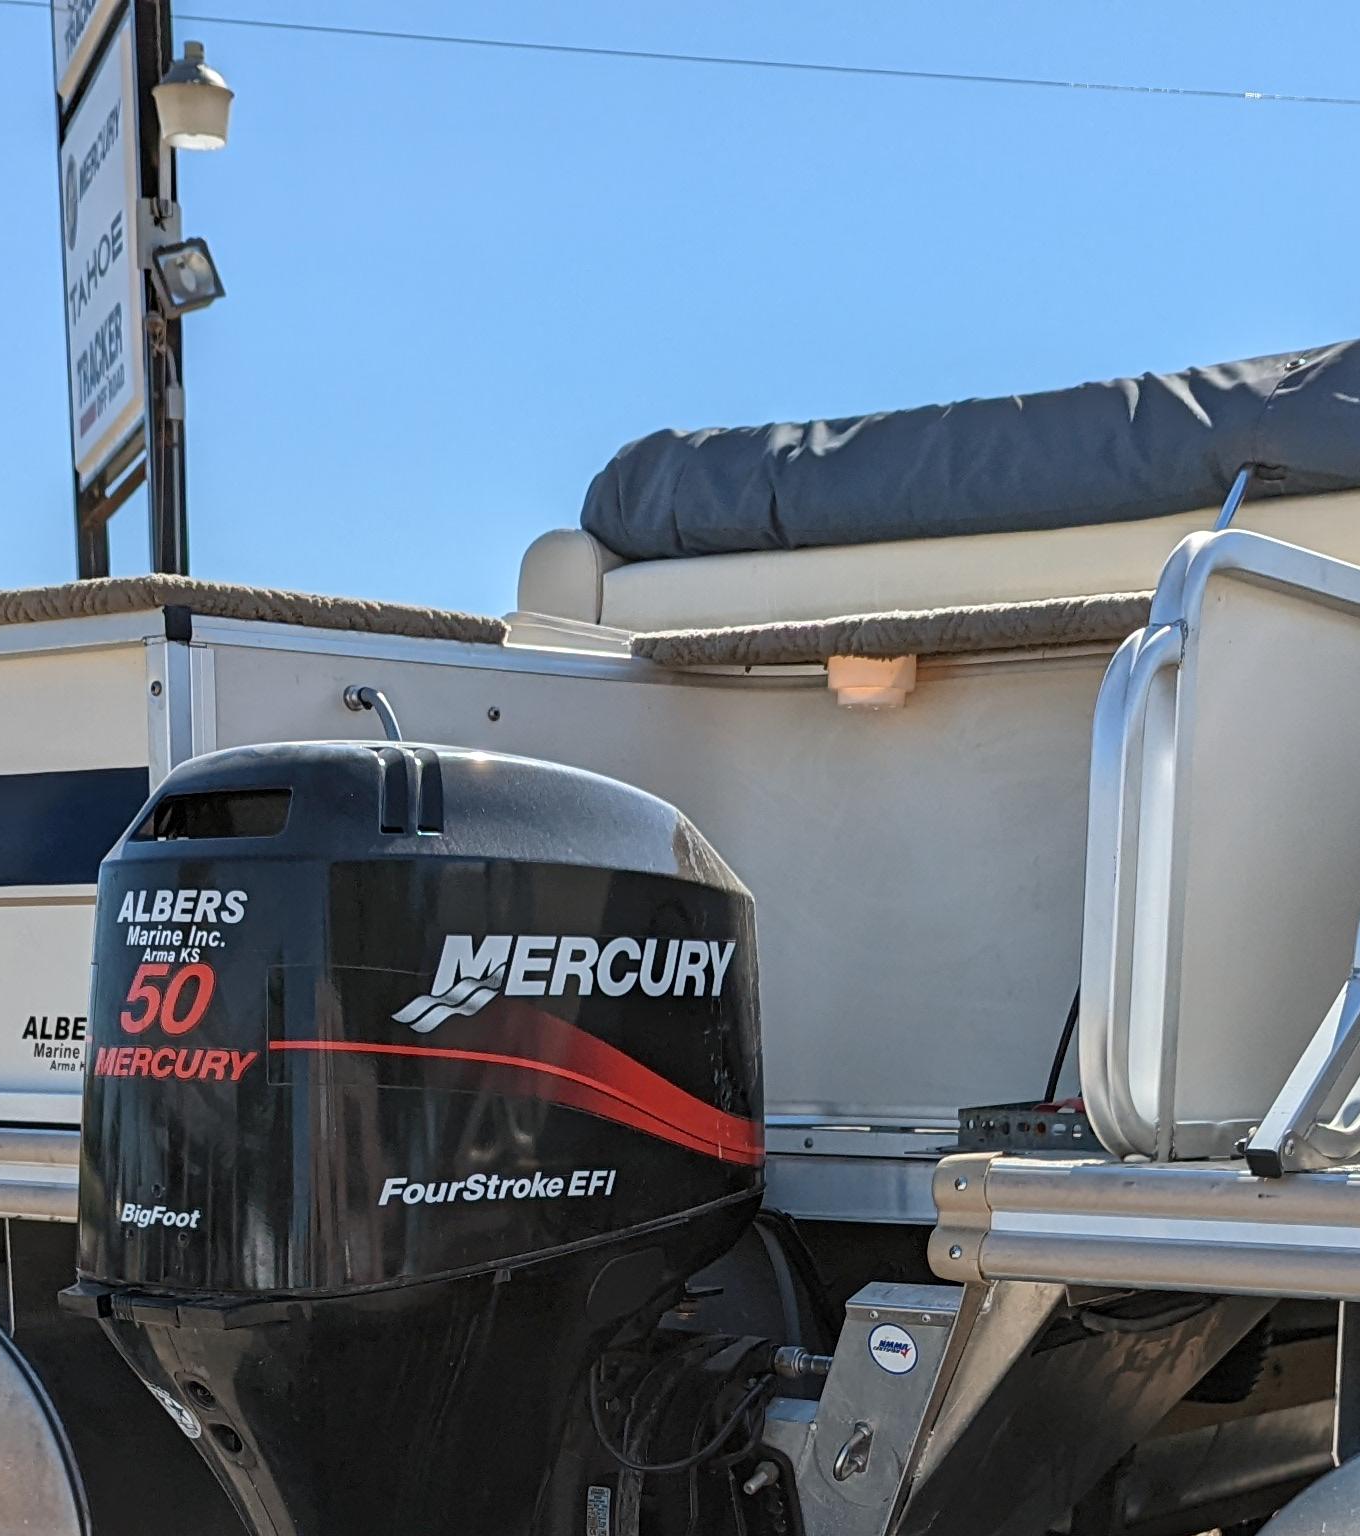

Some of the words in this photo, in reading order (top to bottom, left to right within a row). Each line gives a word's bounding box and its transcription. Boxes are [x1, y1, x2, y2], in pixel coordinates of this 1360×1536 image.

[79, 99, 121, 203] MERCURY
[70, 210, 123, 326] TAHOE
[77, 302, 123, 409] TRACKER
[117, 889, 248, 924] ALBERS
[126, 925, 183, 946] Marine
[188, 926, 226, 948] Inc.
[142, 948, 175, 963] Arma
[179, 948, 201, 963] KS
[431, 934, 737, 998] MERCURY
[120, 963, 217, 1036] 50
[22, 1015, 87, 1041] ALBE
[33, 1042, 81, 1059] Marine
[49, 1060, 76, 1072] Arma
[93, 1046, 258, 1082] MERCURY
[378, 1171, 564, 1206] FourStroke
[567, 1169, 617, 1198] EFI
[121, 1203, 201, 1228] BigFoot
